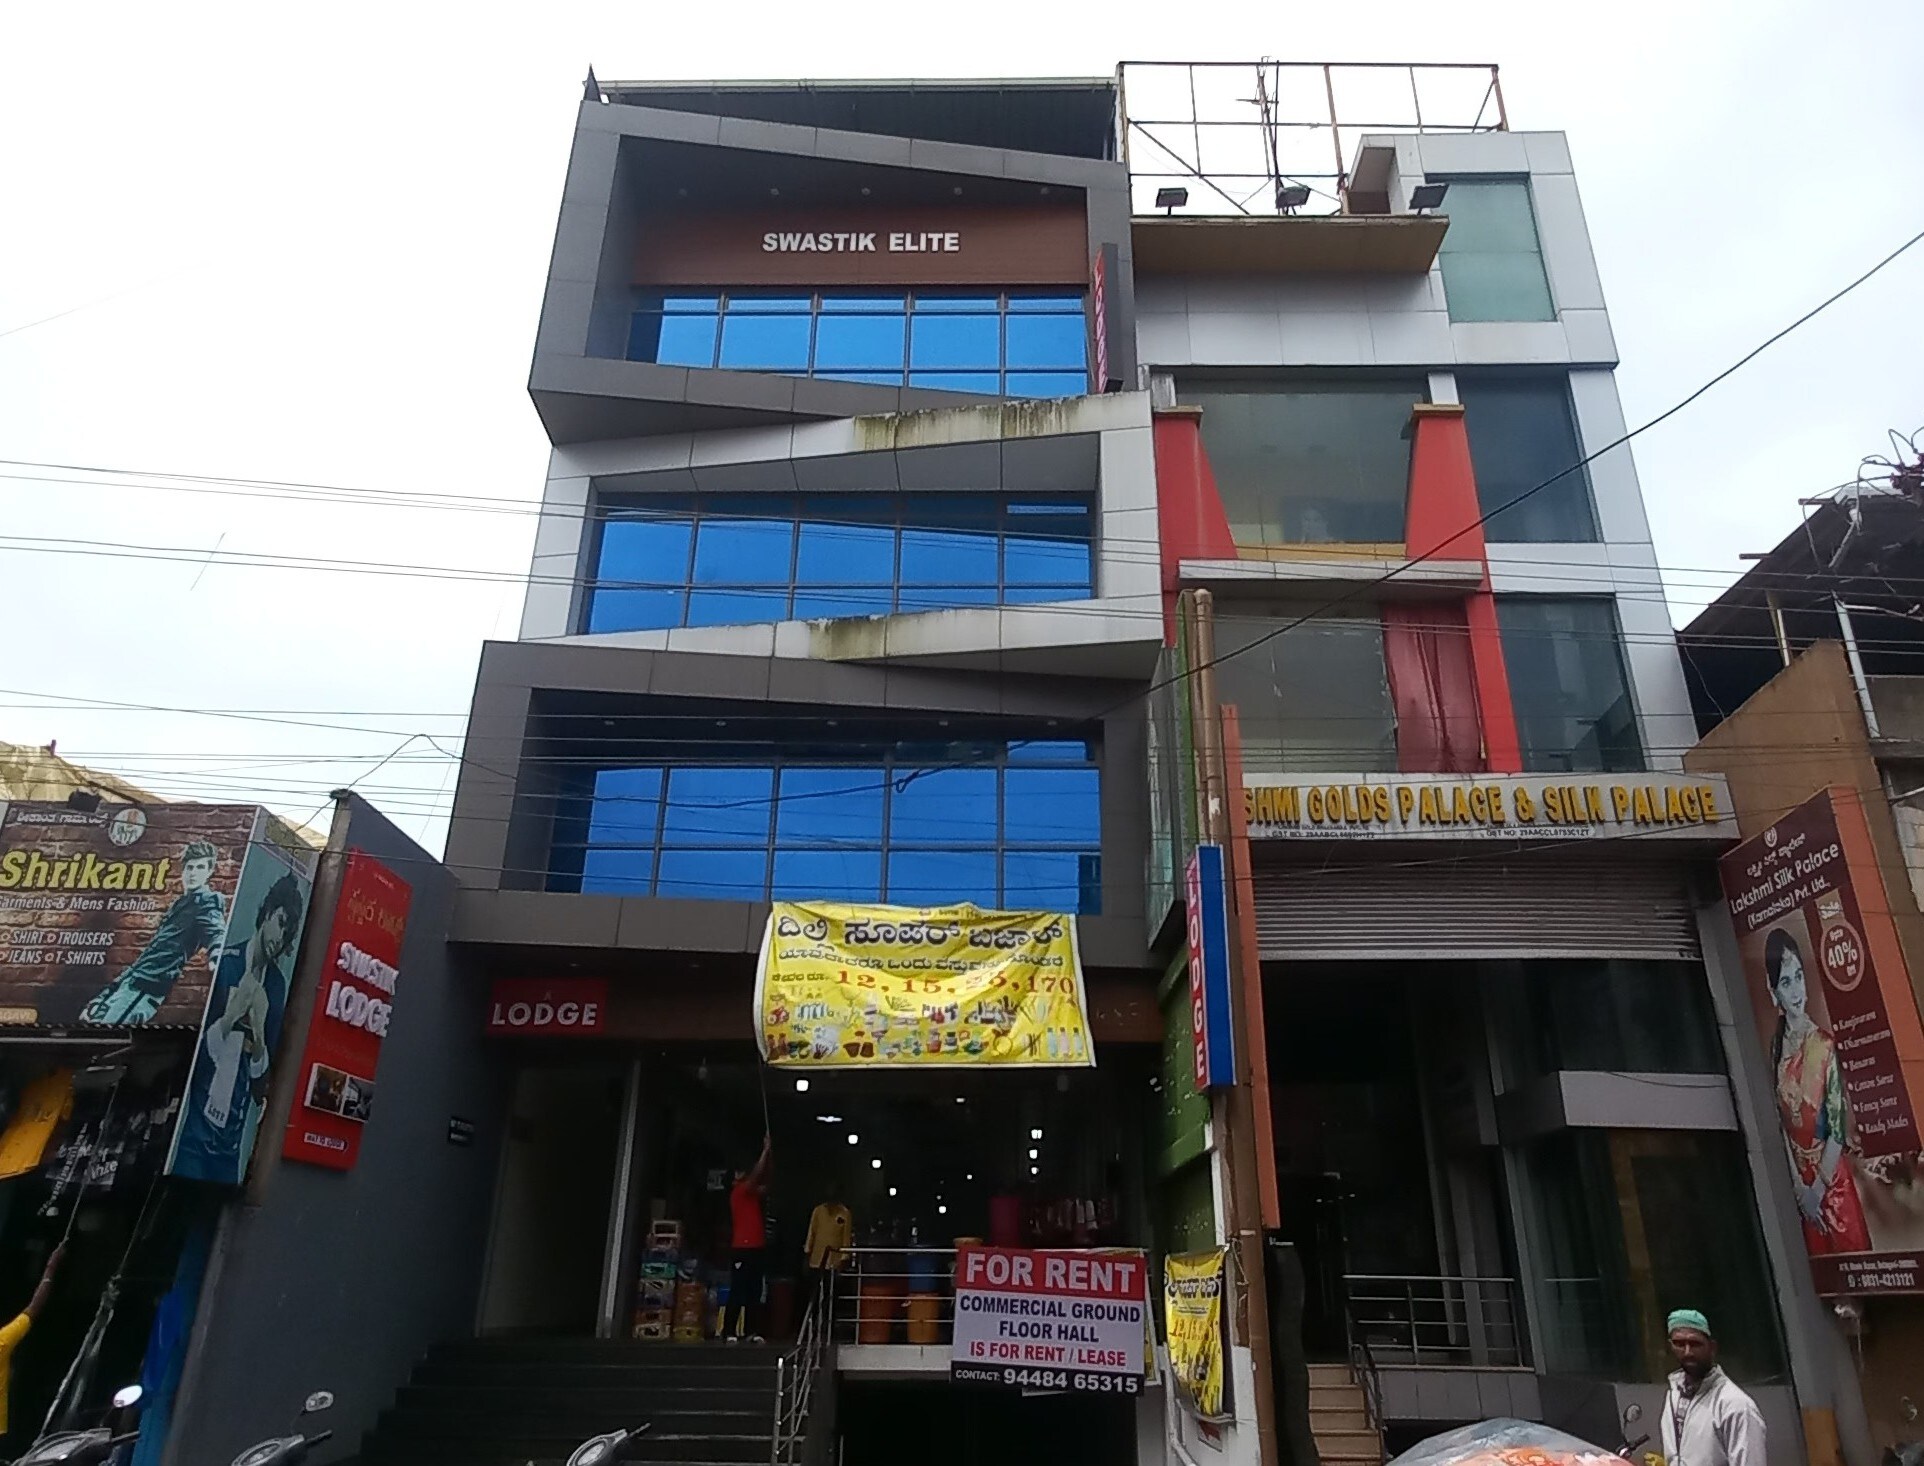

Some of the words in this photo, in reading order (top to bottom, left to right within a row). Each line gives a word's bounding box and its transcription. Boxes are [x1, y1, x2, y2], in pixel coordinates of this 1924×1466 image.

[763, 233, 876, 252] SWASTIK
[889, 233, 960, 252] ELITE
[1307, 785, 1391, 823] GOLDS
[1514, 786, 1535, 823] &
[1543, 785, 1605, 825] SILK
[1610, 785, 1721, 826] PALACE
[0, 850, 171, 891] Shrikant
[1730, 876, 1774, 914] Lakshmi
[1773, 866, 1796, 890] Silk
[1794, 843, 1839, 877] Palace
[69, 897, 103, 911] Mens
[107, 897, 156, 911] Fashion
[12, 931, 45, 945] SHIRT
[57, 932, 115, 946] TROUSERS
[845, 918, 961, 946] ಸೂಪರ್
[7, 949, 42, 964] JEANS
[55, 950, 106, 965] T-SHIRTS
[1828, 940, 1858, 969] 40%
[1027, 974, 1075, 994] 170
[1189, 878, 1205, 1078] LODGE
[326, 980, 393, 1038] LODGE
[492, 1002, 598, 1026] LODGE
[966, 1252, 1033, 1287] FOR
[1045, 1257, 1136, 1293] RENT
[960, 1295, 1067, 1318] COMMERCIAL
[1072, 1302, 1140, 1323] GROUND
[1000, 1321, 1052, 1339] FLOOR
[1057, 1325, 1099, 1343] HALL
[970, 1341, 985, 1357] IS
[989, 1342, 1019, 1360] FOR
[1024, 1344, 1065, 1363] RENT
[1068, 1349, 1075, 1364] /
[1077, 1348, 1126, 1367] LEASE
[955, 1369, 1000, 1382] CONTACT:
[1003, 1368, 1068, 1388] 94484
[1074, 1373, 1138, 1393] 65315
